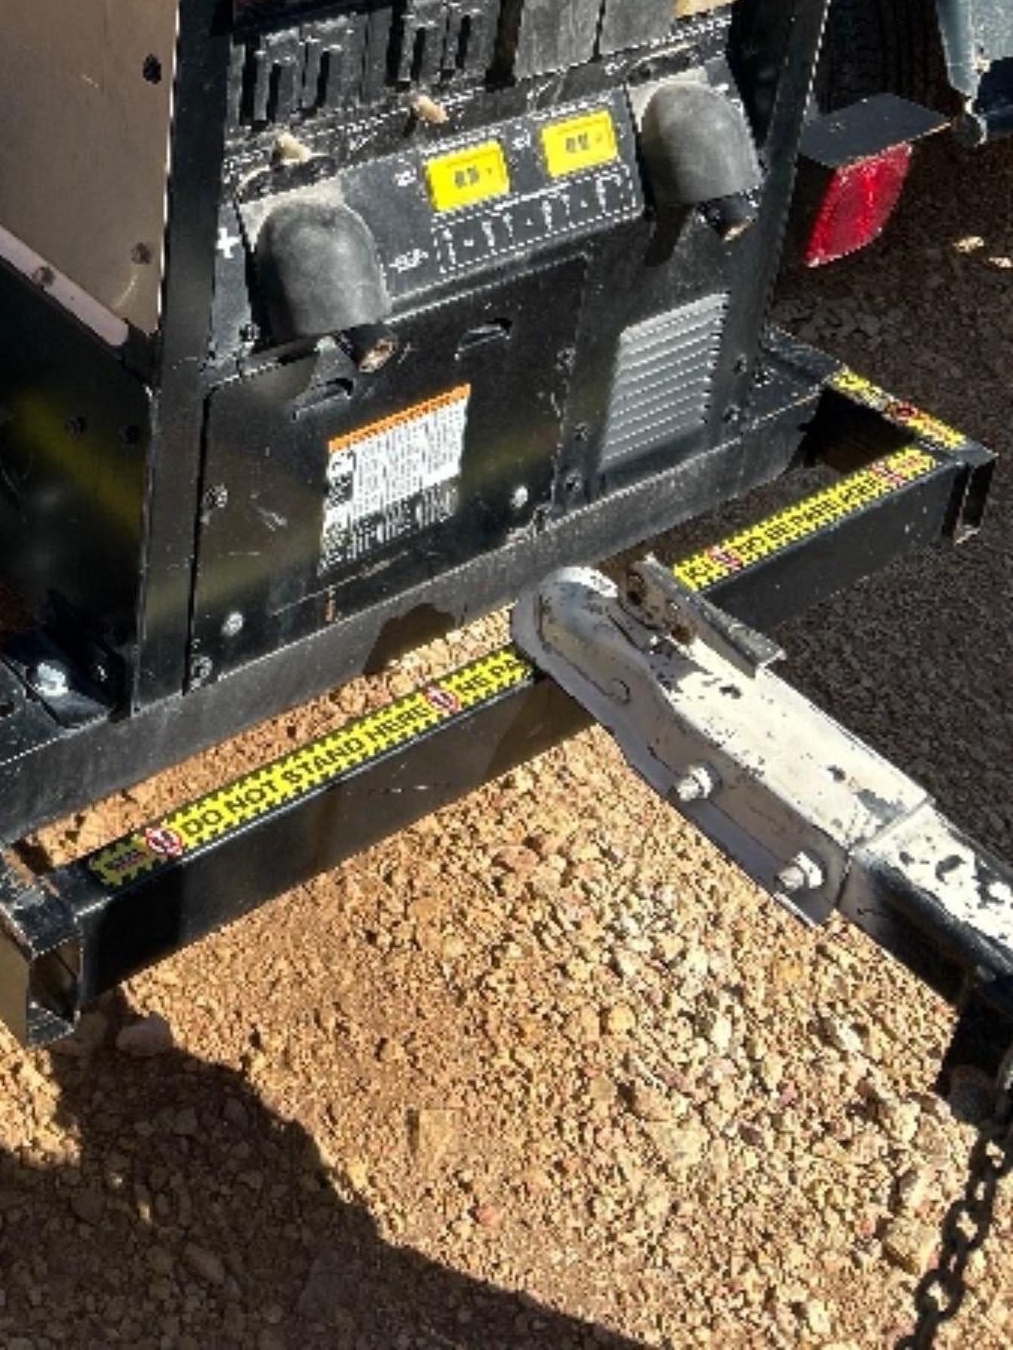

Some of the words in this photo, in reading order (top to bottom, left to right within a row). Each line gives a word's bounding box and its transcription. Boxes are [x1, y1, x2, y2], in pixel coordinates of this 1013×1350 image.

[492, 654, 524, 684] PA
[181, 806, 225, 840] DO
[230, 785, 274, 816] NOT
[283, 736, 365, 787] STAND
[366, 703, 431, 746] HERE
